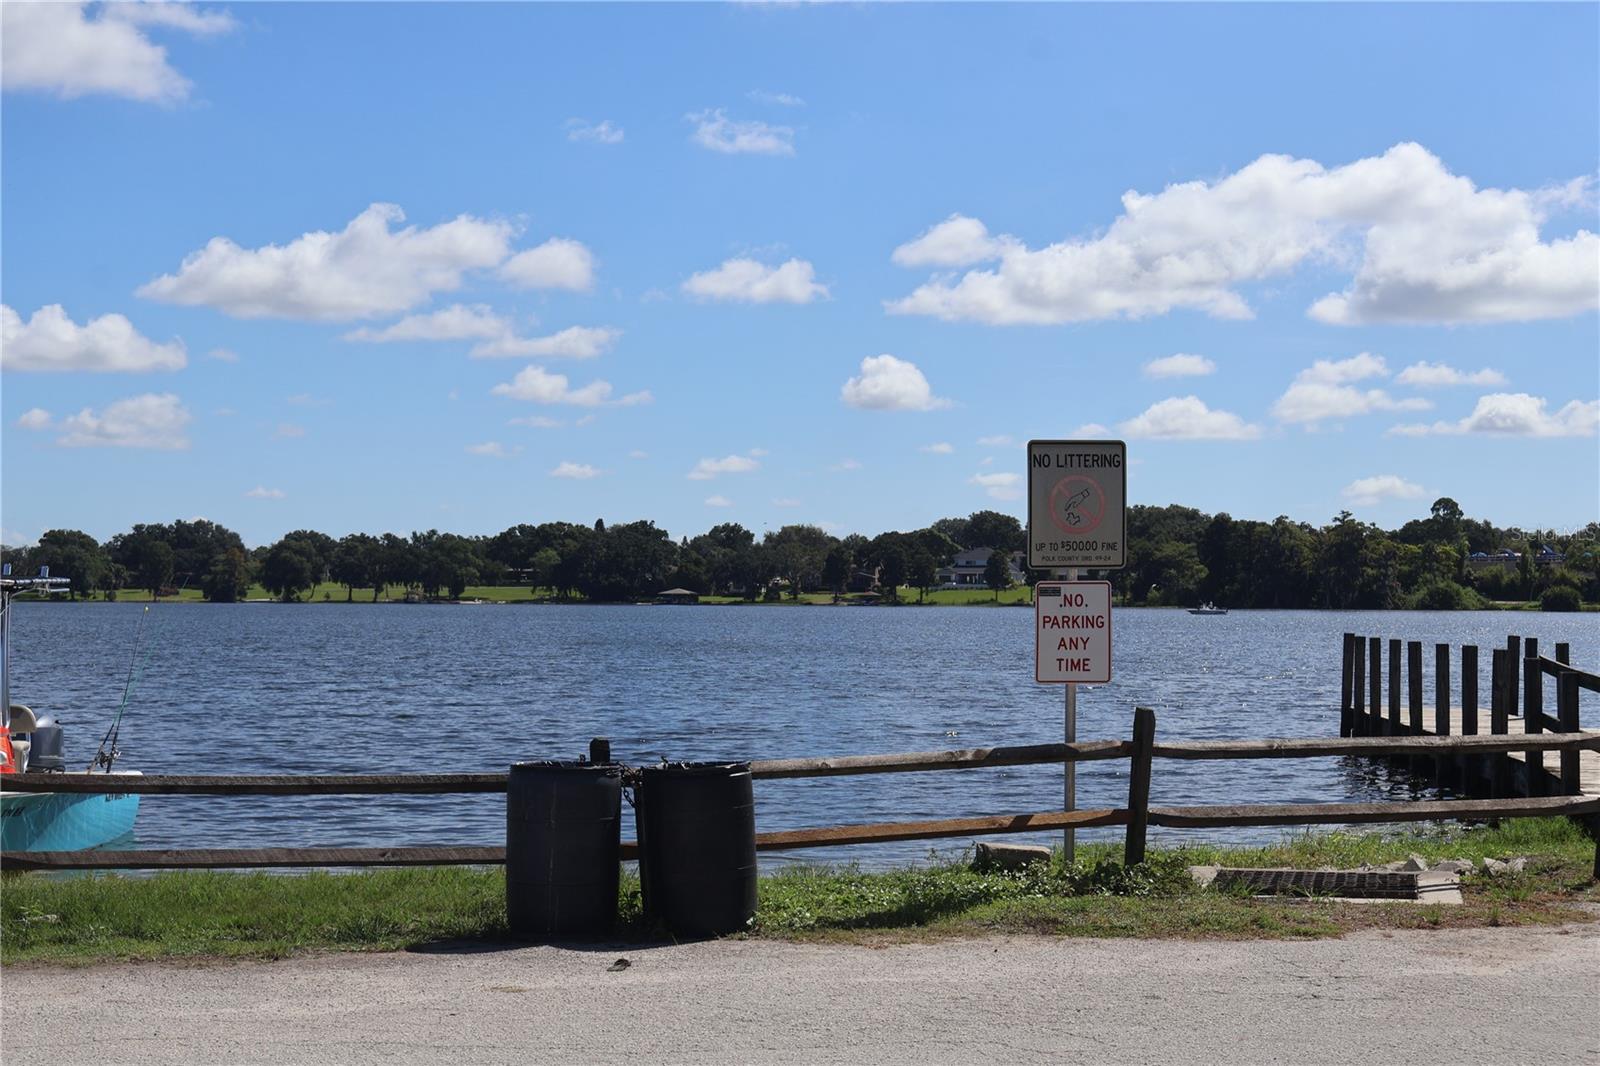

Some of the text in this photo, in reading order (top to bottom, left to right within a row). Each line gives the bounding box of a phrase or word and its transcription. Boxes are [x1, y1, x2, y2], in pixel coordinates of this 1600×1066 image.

[1033, 454, 1121, 468] NO LITTERING
[1035, 543, 1046, 552] UP
[1049, 543, 1059, 552] TO
[1101, 543, 1118, 551] FINE
[1042, 615, 1105, 629] PARKING
[1057, 637, 1090, 650] ANY
[1056, 658, 1091, 672] TIME
